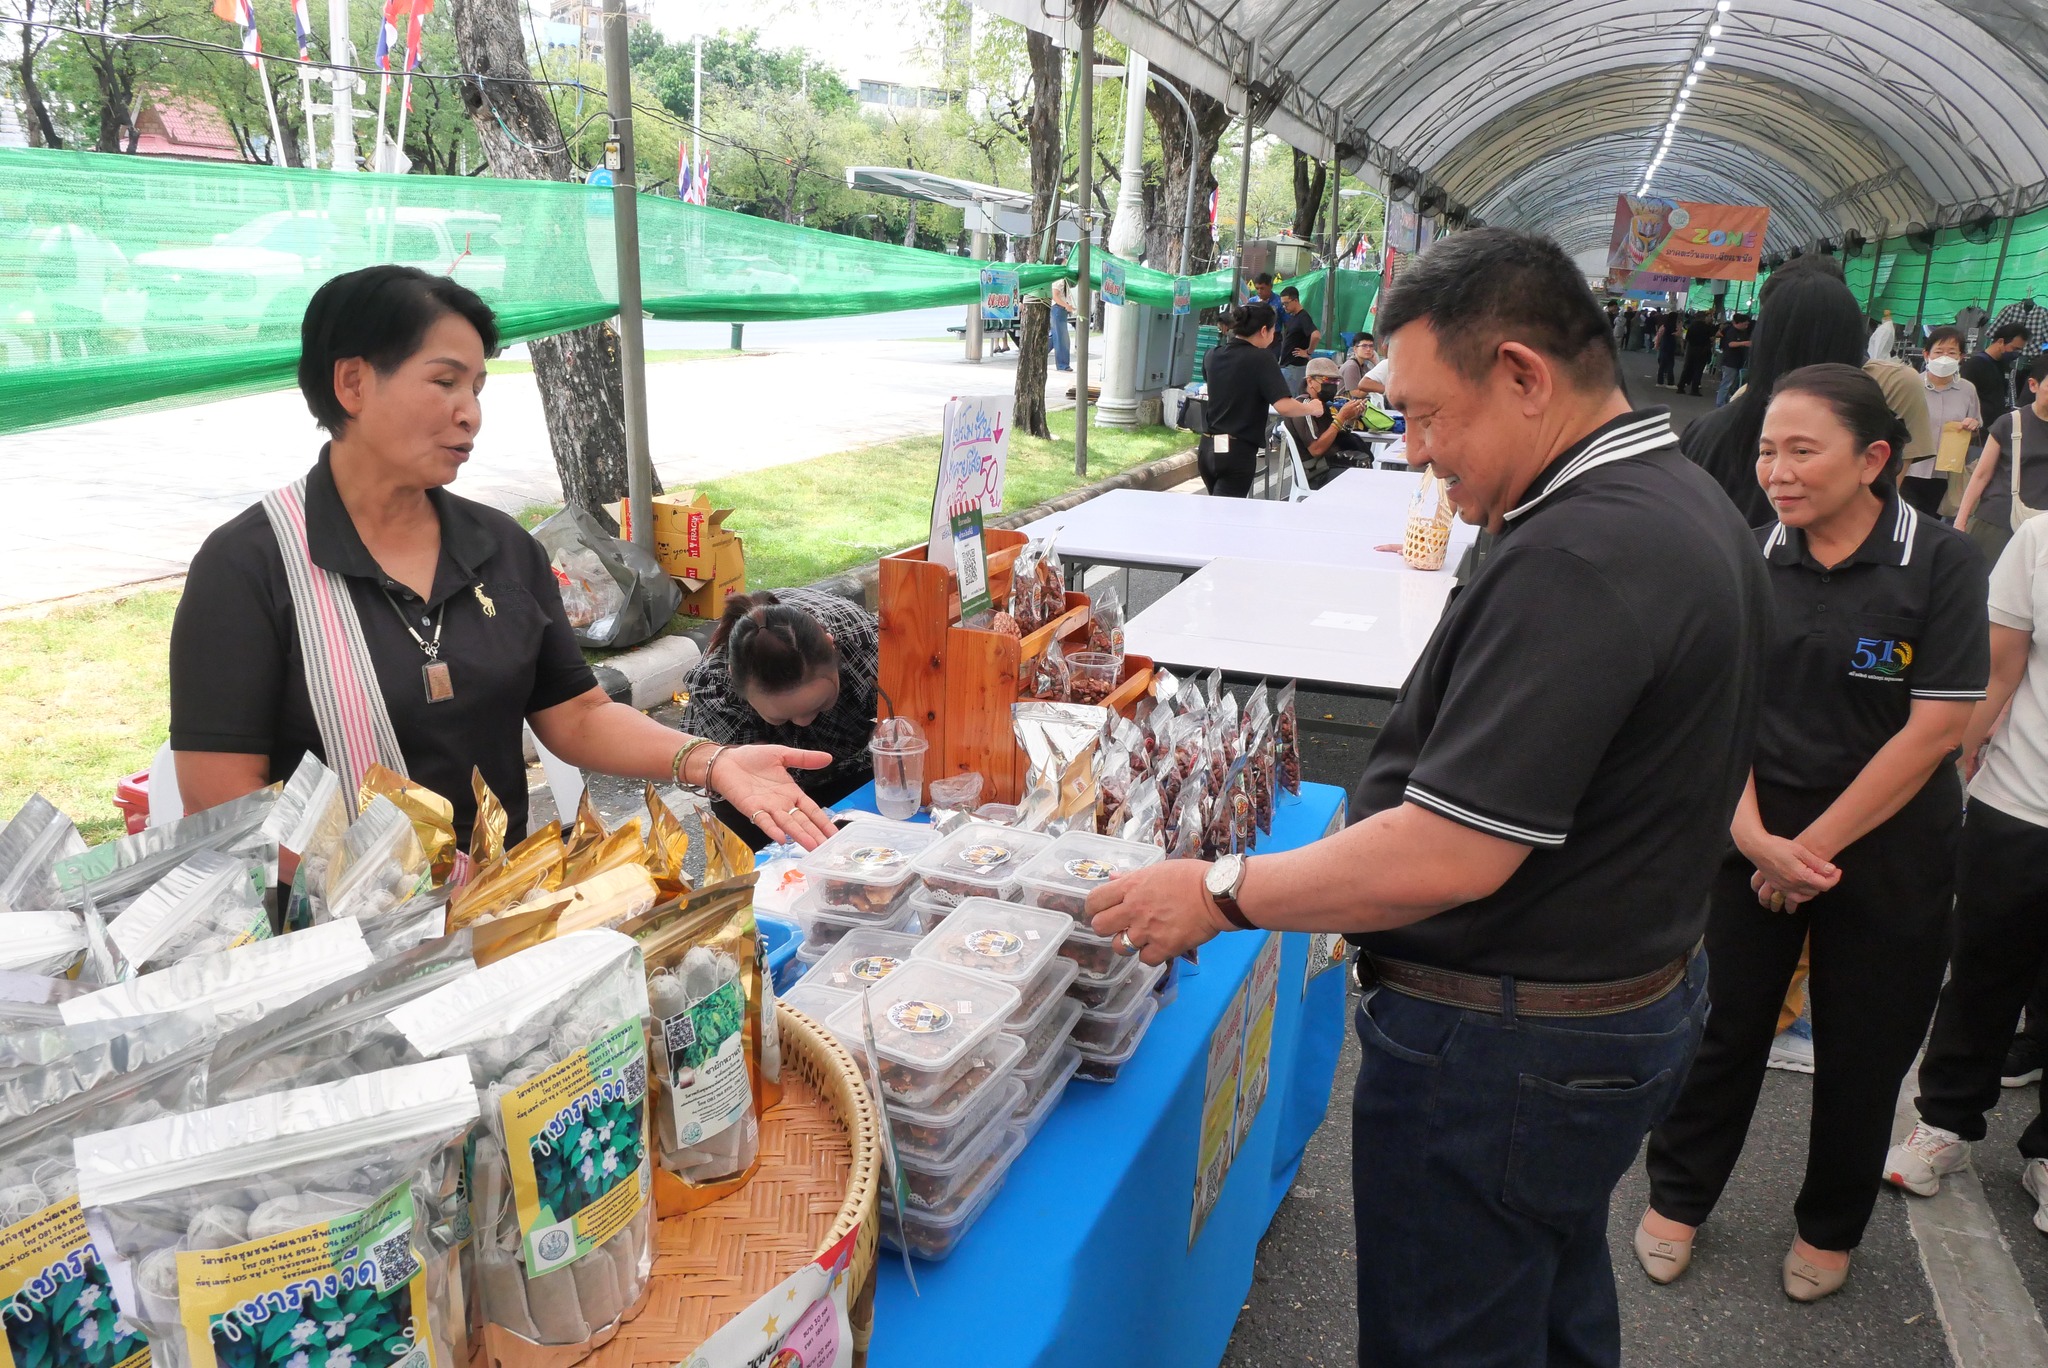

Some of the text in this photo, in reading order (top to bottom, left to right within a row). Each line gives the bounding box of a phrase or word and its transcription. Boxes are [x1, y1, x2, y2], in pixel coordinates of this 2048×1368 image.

[1692, 228, 1757, 249] ZONE
[976, 455, 998, 500] 50
[705, 1045, 742, 1076] ชาผักหวานป่
[550, 1067, 626, 1136] ชารางจืด
[69, 1213, 84, 1225] 895
[32, 1243, 101, 1296] ชารา
[259, 1255, 276, 1266] 081
[296, 1246, 317, 1258] 8956
[244, 1247, 377, 1322] ชารางจืด
